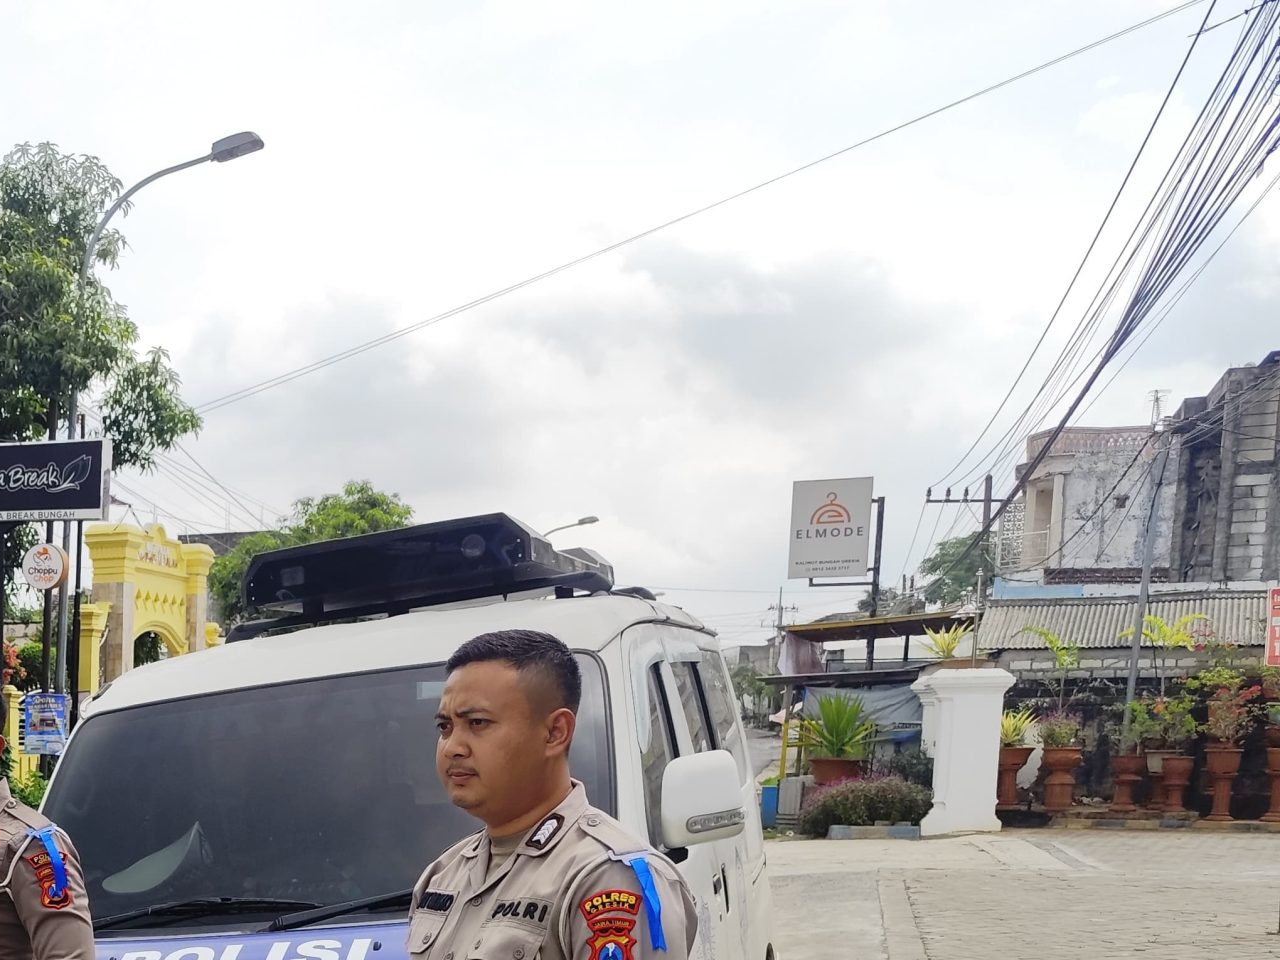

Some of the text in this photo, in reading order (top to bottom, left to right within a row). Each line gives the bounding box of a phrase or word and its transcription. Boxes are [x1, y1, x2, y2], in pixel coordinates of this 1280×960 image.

[6, 463, 61, 490] Break
[6, 512, 35, 521] BREAK
[37, 511, 75, 520] BUNGAH
[795, 526, 865, 540] ELMODE
[27, 566, 58, 585] Choppu Chop
[491, 900, 549, 923] POLRI
[584, 892, 637, 912] POLRES
[590, 901, 630, 914] GRESIK
